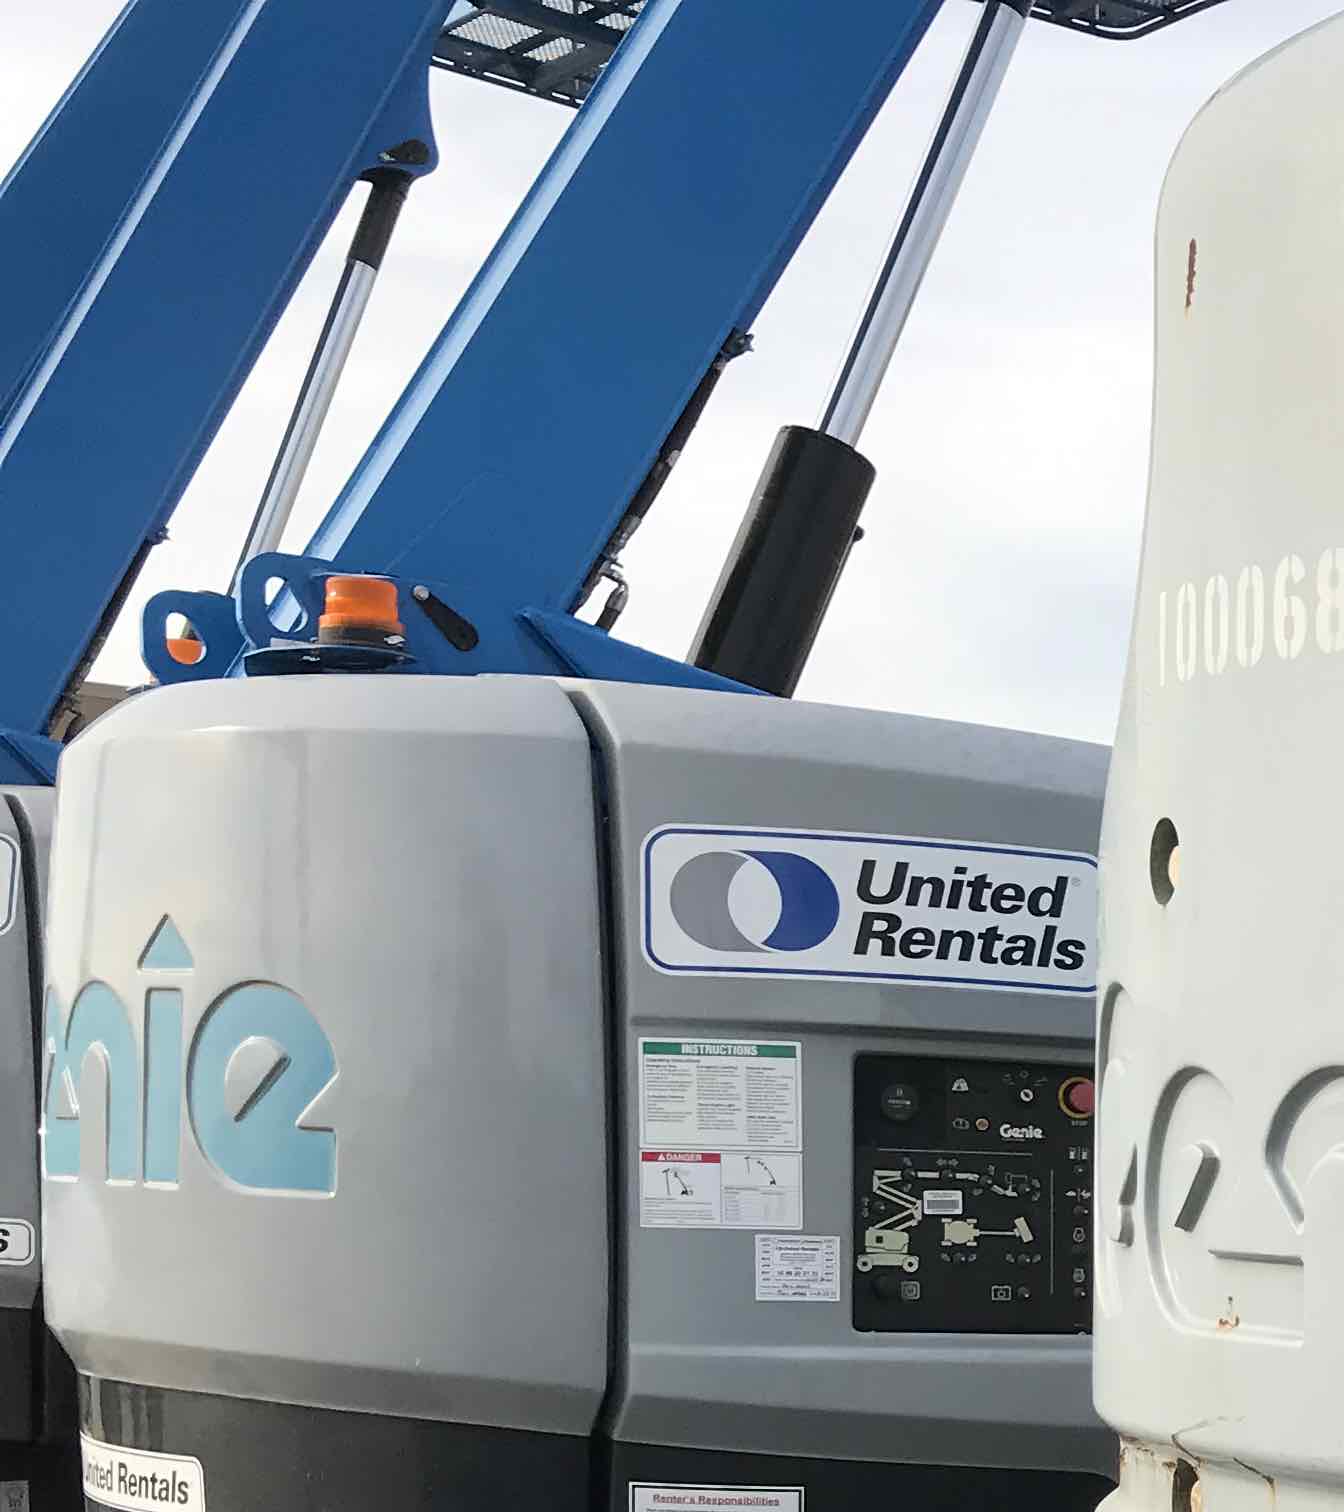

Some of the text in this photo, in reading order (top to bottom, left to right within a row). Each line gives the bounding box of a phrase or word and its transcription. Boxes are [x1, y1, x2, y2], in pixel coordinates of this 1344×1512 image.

[856, 859, 1069, 918] United
[853, 911, 1087, 971] Rentals
[681, 1043, 758, 1056] INSTRUCTIONS
[999, 1123, 1044, 1139] Genie
[666, 1153, 702, 1161] DANGER
[118, 1461, 189, 1505] Rentals
[653, 1494, 780, 1507] Renter's Responsibilities
